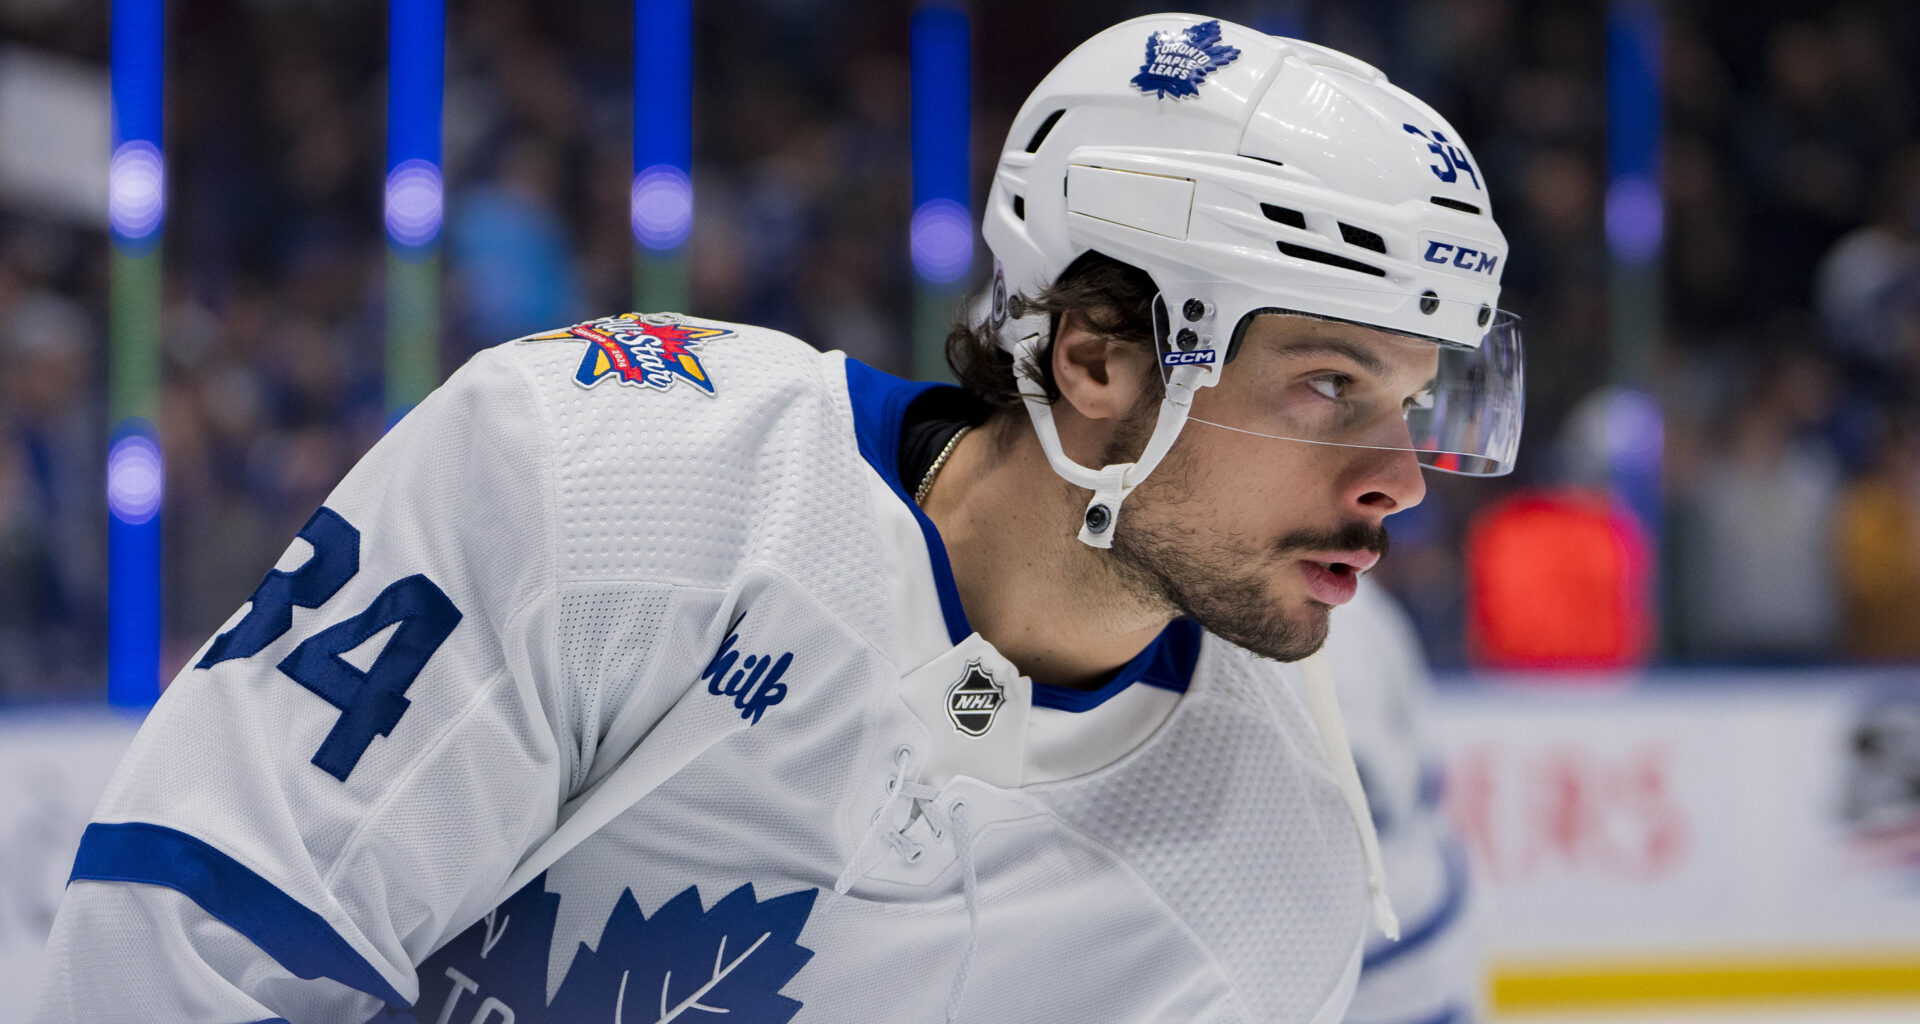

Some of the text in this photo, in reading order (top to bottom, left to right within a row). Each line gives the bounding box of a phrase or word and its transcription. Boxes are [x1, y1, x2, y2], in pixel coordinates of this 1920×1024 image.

[1153, 42, 1211, 66] TORONTO
[1154, 54, 1196, 70] MAPLE
[1148, 64, 1190, 80] LEAFS
[1402, 122, 1481, 190] 34
[1424, 240, 1498, 275] CCM
[1164, 351, 1214, 364] CCM
[954, 695, 995, 709] NHL
